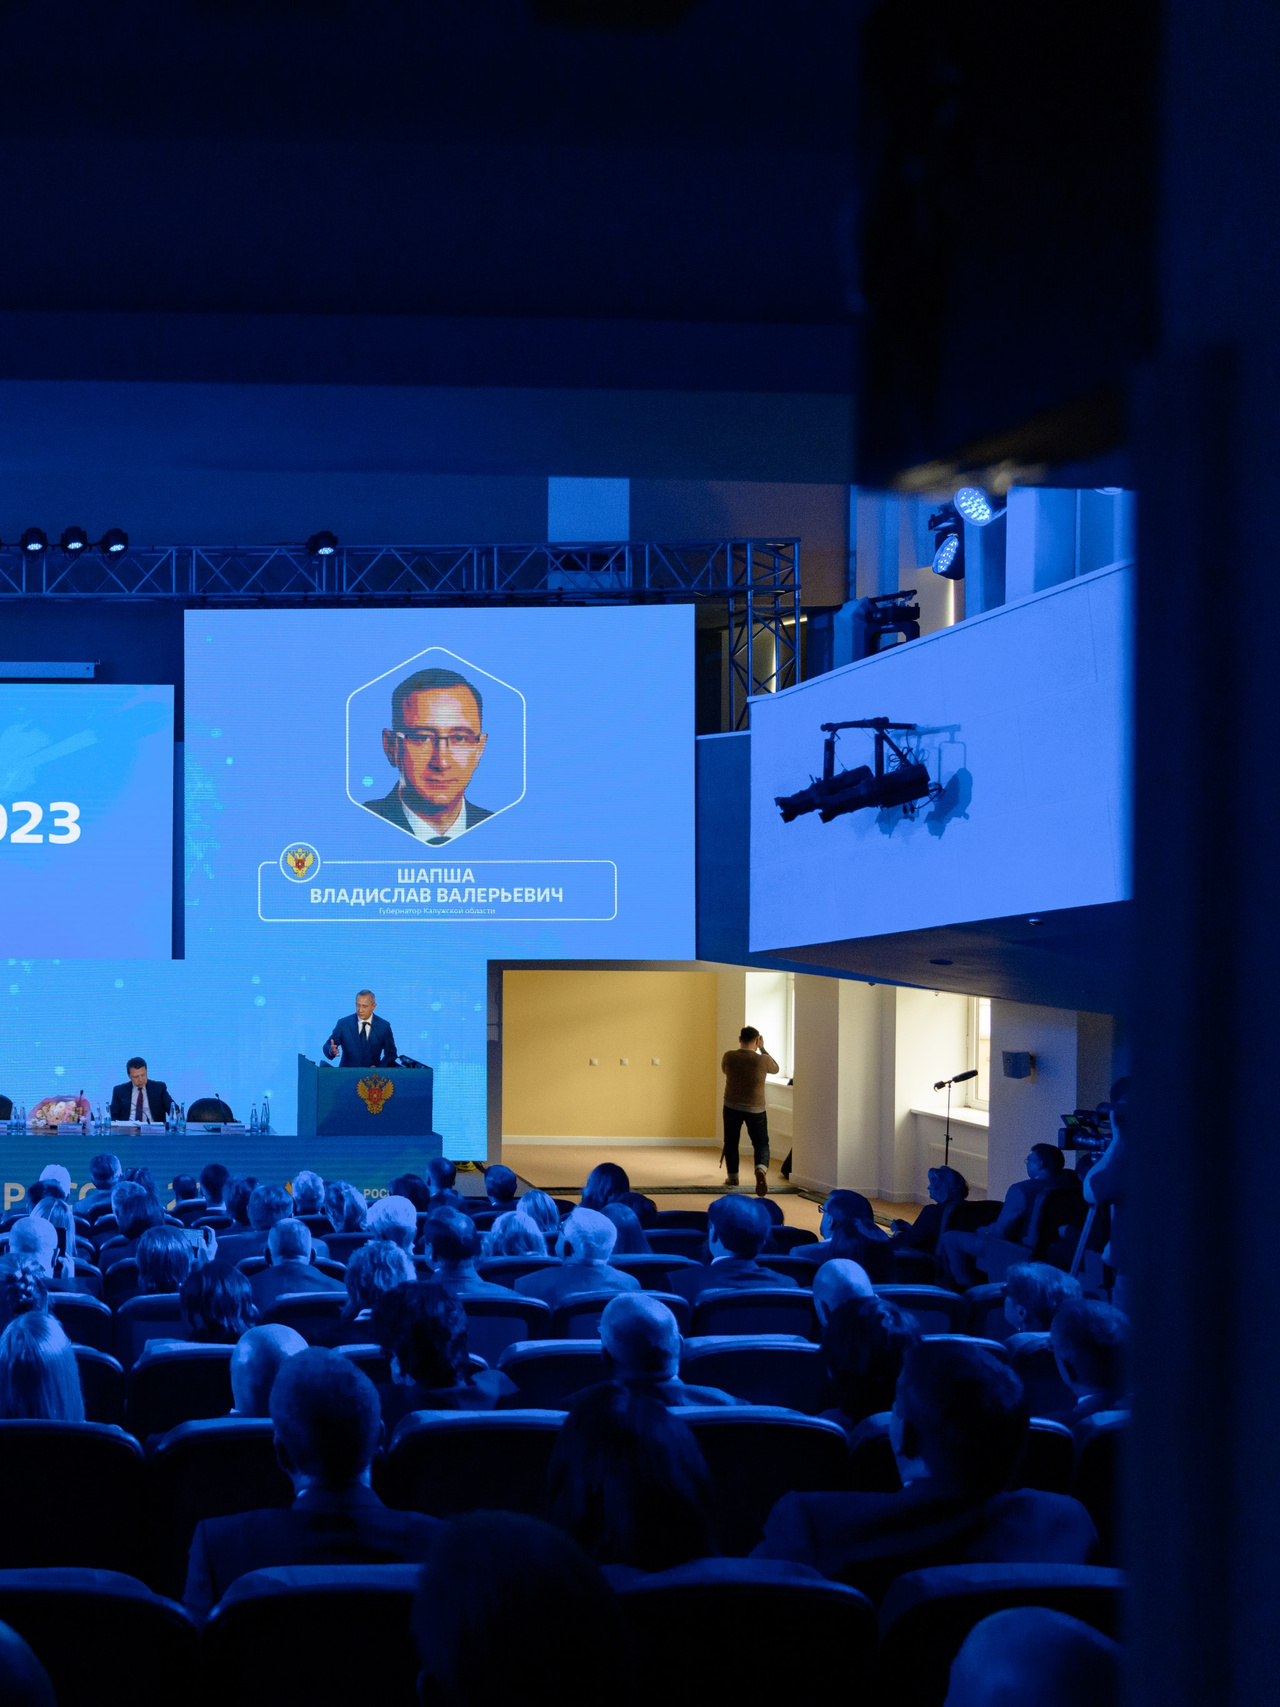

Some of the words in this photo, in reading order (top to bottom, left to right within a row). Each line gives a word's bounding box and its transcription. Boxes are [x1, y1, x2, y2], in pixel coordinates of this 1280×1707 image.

[397, 868, 474, 883] ШАПША
[310, 887, 431, 907] ВЛАДИСЛАВ
[437, 887, 563, 903] ВАЛЕРЬЕВИЧ
[379, 907, 422, 915] Губернатор
[424, 907, 463, 915] Калужской
